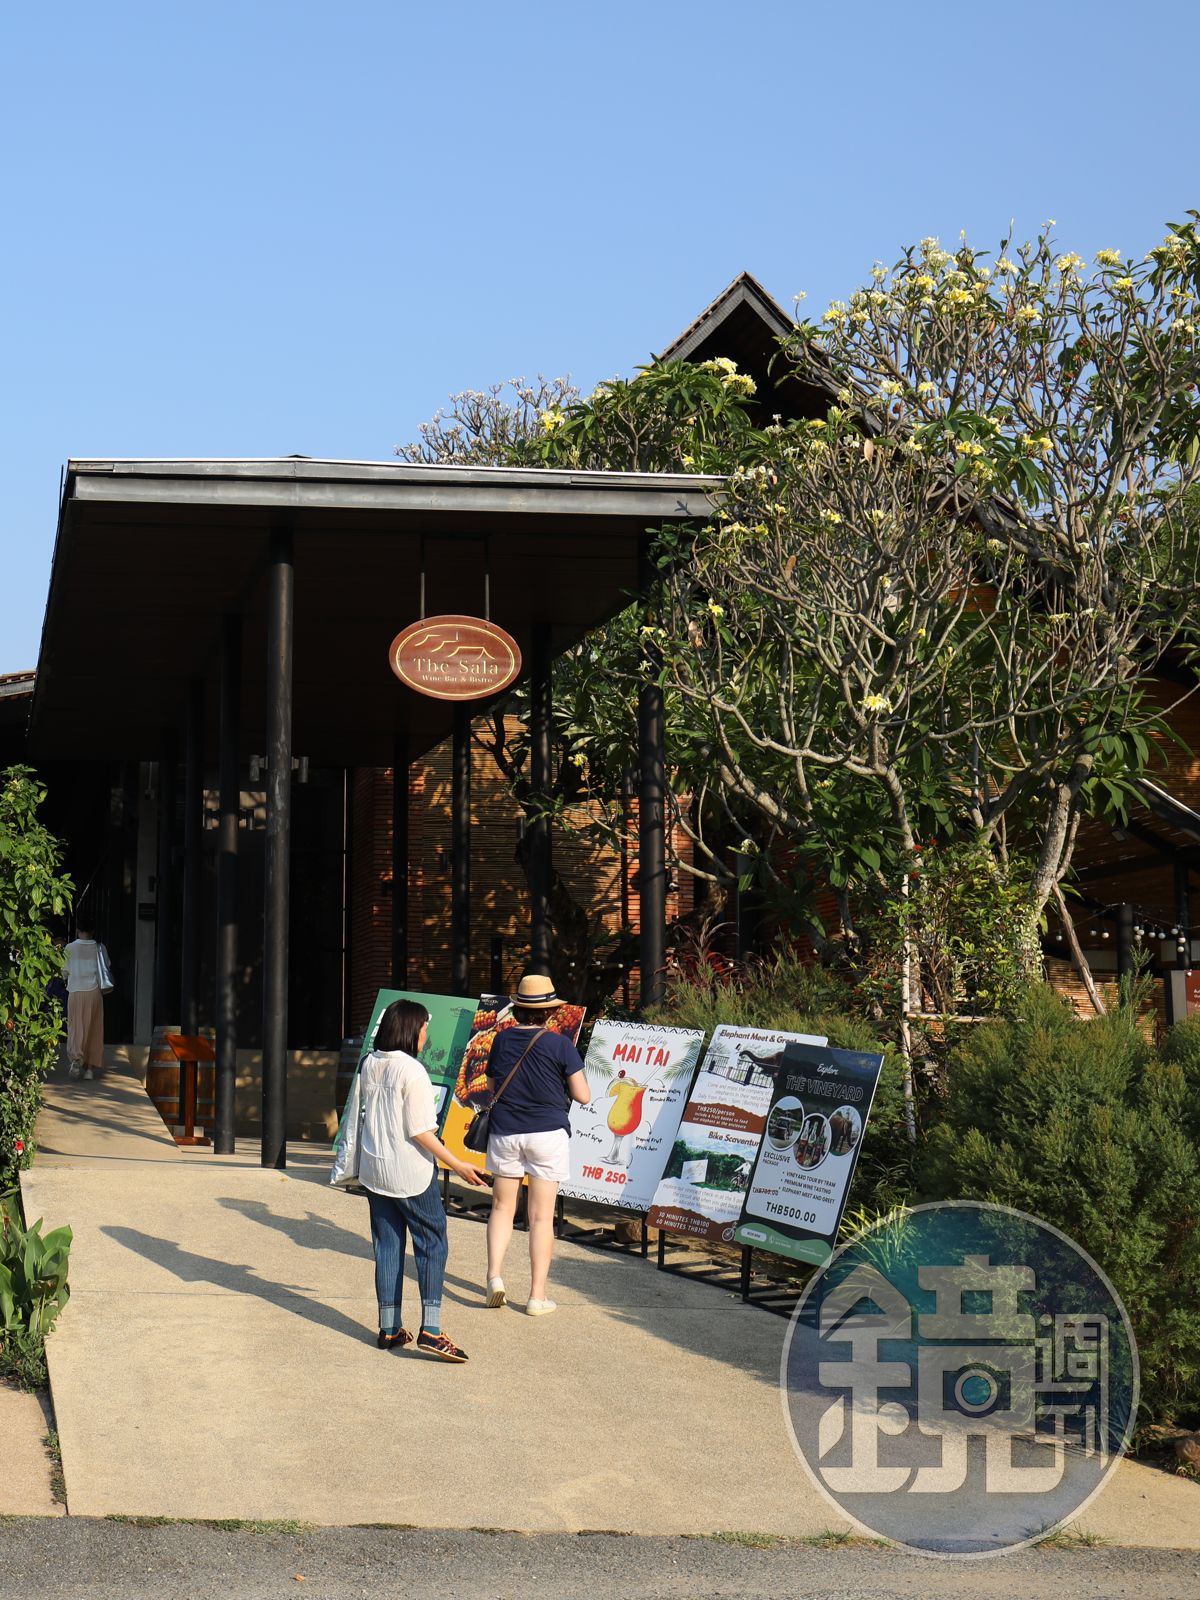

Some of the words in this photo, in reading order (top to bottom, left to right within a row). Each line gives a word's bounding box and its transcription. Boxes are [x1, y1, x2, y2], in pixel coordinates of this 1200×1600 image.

[414, 658, 449, 673] The
[460, 660, 498, 674] Sala
[720, 1029, 750, 1040] Elephant
[750, 1033, 768, 1041] Meet
[769, 1034, 775, 1042] &
[612, 1044, 642, 1063] MAI
[645, 1046, 671, 1067] TAI
[785, 1074, 807, 1092] THE
[807, 1078, 864, 1101] VINEYARD
[708, 1131, 723, 1141] Bike
[763, 1151, 790, 1163] EXCLUSIVE
[582, 1165, 604, 1180] THB
[824, 1180, 836, 1188] TRAM
[814, 1186, 832, 1195] TASTING
[666, 1213, 689, 1223] MINUTES
[766, 1201, 816, 1223] THB500.00
[664, 1220, 686, 1230] MINUTES
